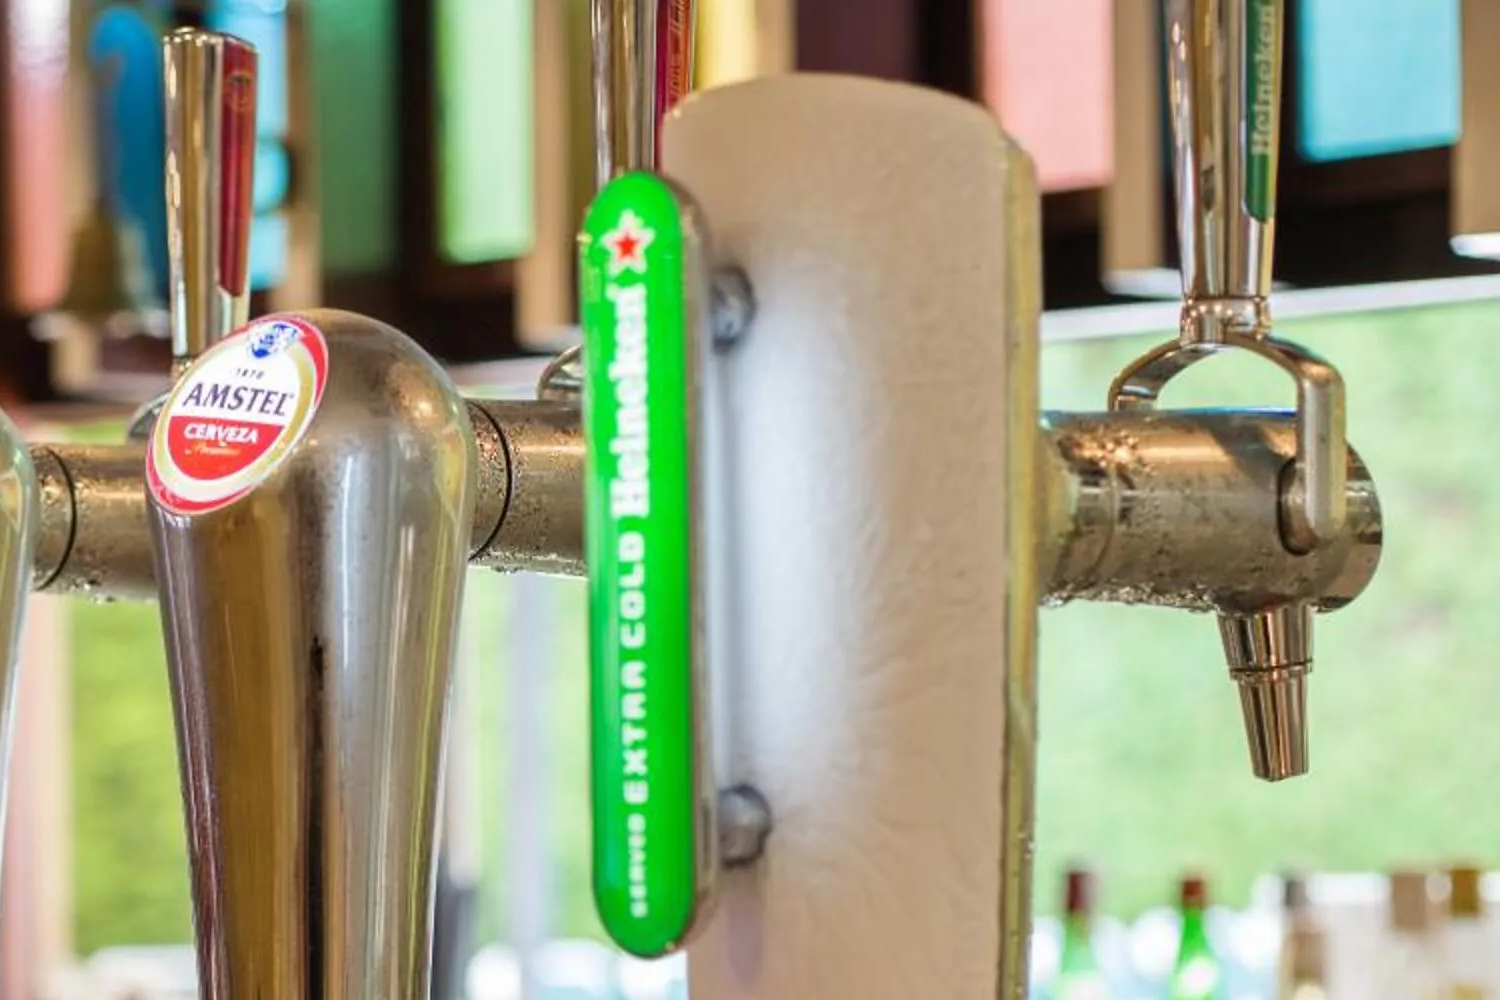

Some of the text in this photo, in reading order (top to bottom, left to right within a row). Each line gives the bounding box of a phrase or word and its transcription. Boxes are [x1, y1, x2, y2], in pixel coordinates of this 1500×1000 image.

[183, 381, 287, 416] AMSTEL
[184, 423, 259, 444] CERVEZA
[605, 282, 649, 519] Heineken
[617, 531, 647, 649] COLD
[621, 660, 649, 805] EXTRA
